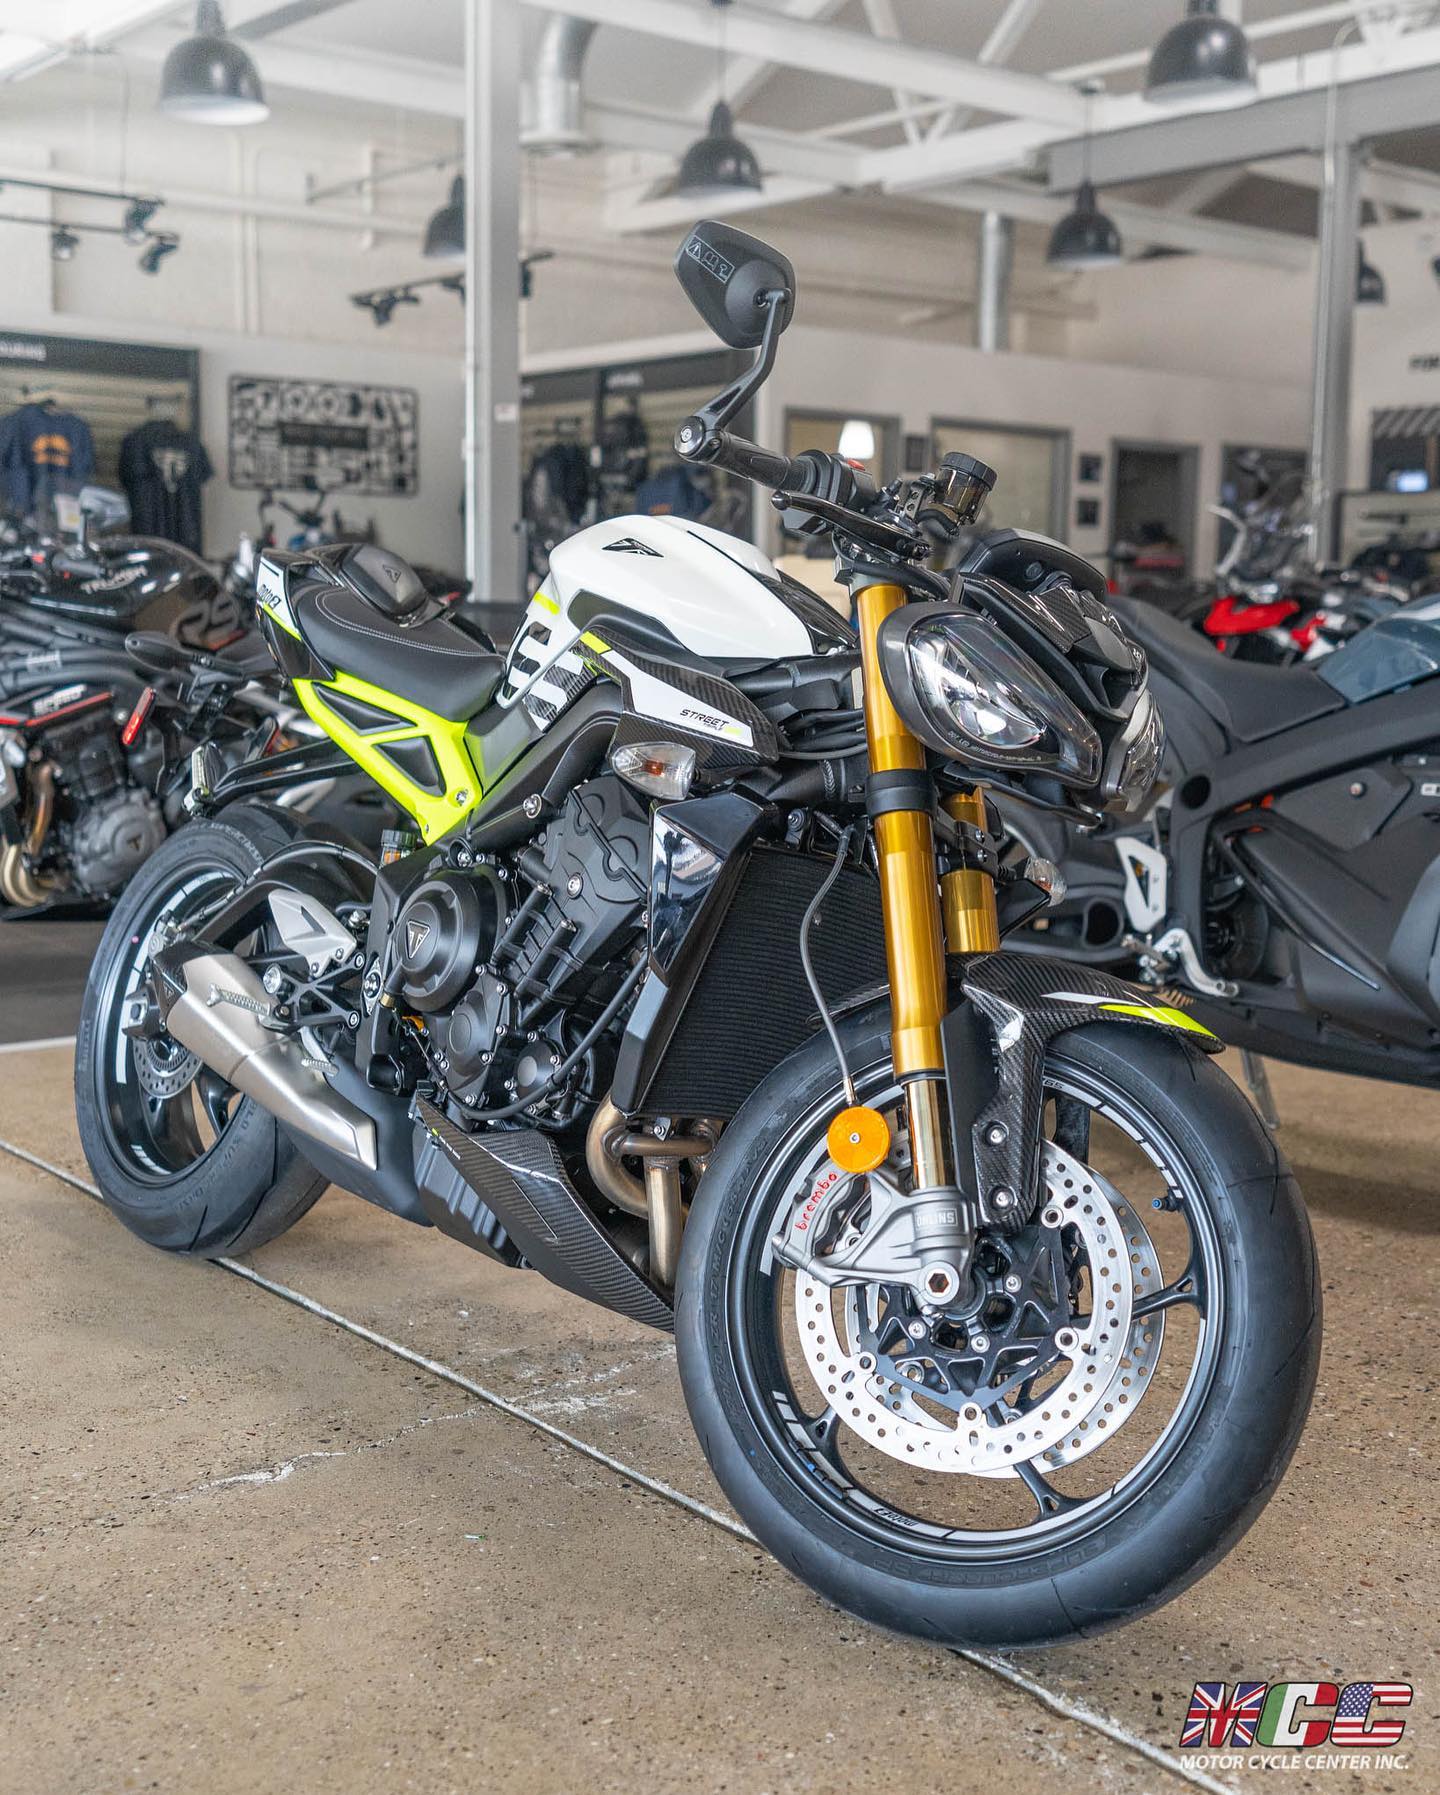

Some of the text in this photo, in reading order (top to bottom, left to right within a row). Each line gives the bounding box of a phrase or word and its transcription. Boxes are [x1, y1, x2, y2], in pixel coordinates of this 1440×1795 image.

[680, 709, 730, 731] STREET
[1043, 1078, 1066, 1089] 65
[795, 1172, 838, 1232] brembo
